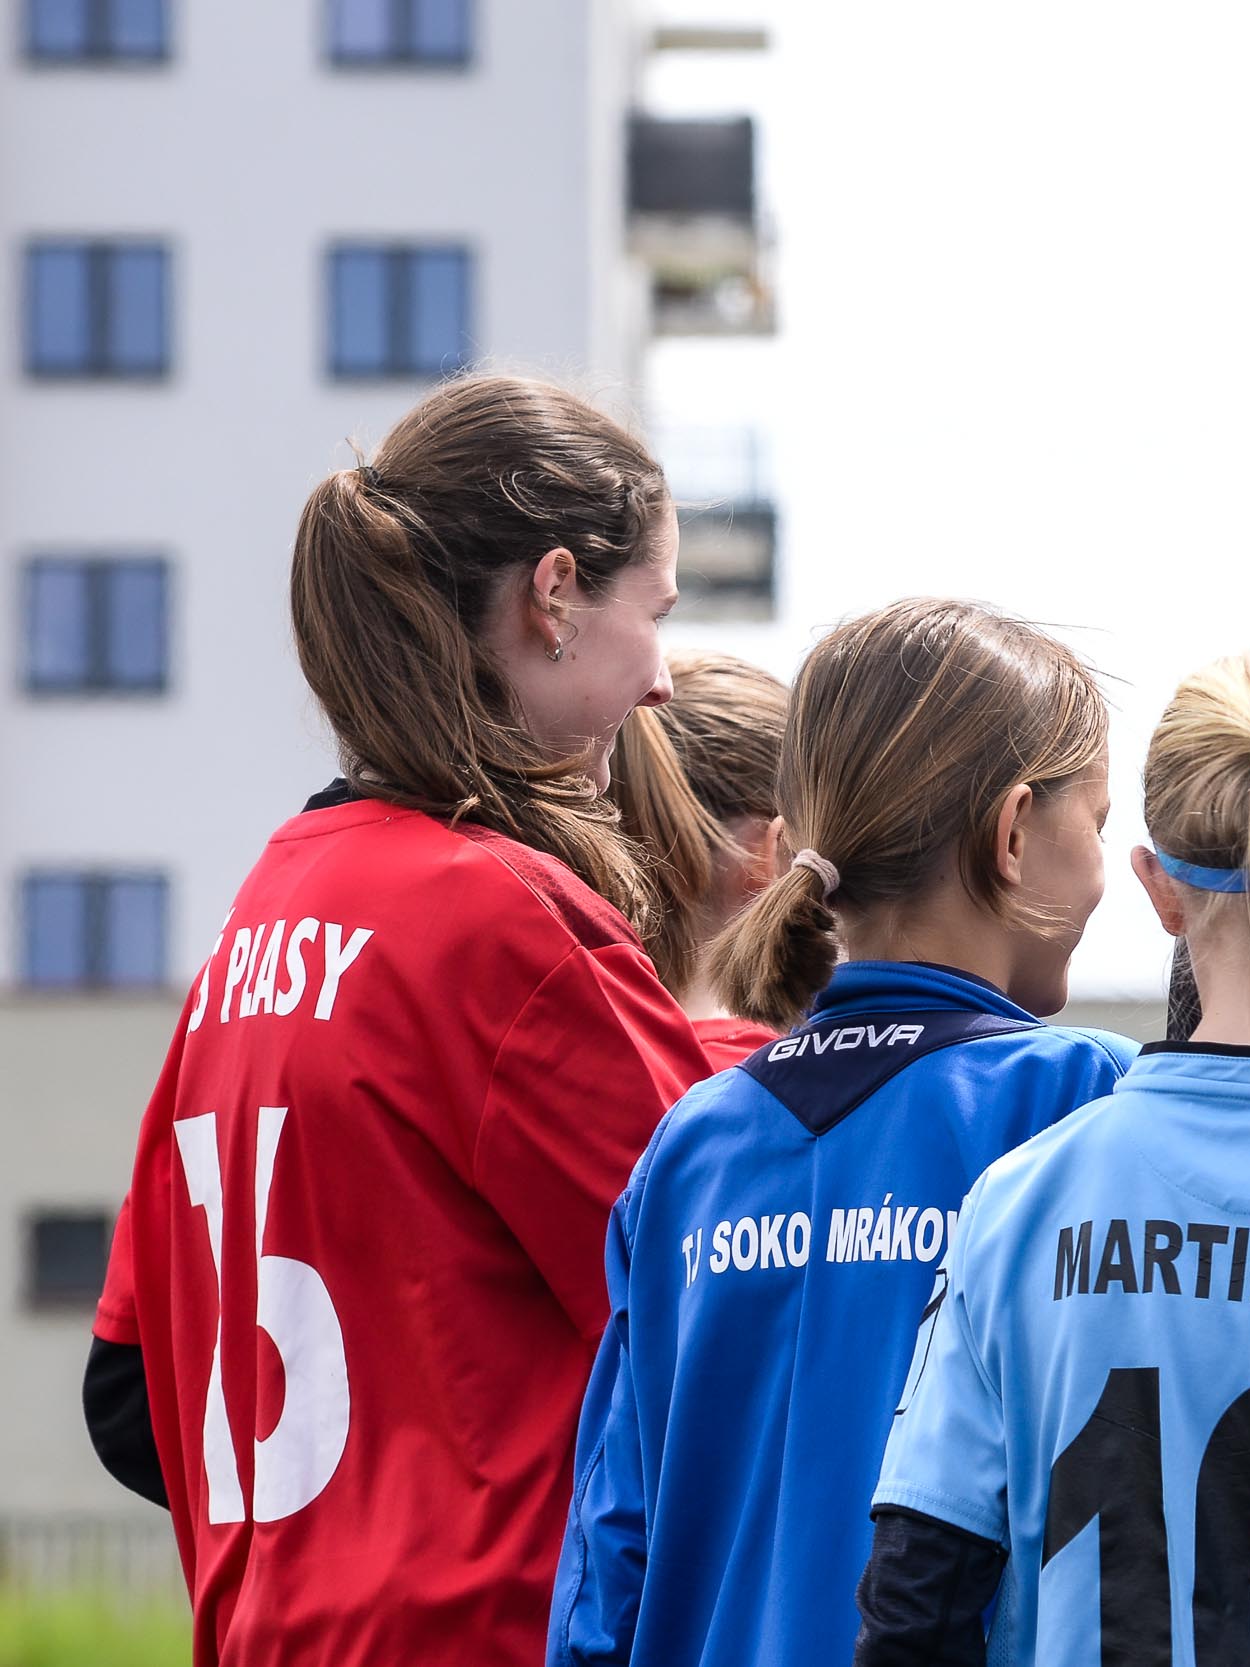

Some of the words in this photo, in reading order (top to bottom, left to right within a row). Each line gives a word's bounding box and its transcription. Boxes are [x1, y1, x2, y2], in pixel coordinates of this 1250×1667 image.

[219, 917, 375, 1024] PLASY
[768, 1024, 924, 1062] GIVOVA
[682, 1227, 703, 1289] TJ
[709, 1211, 812, 1273] SOKO
[173, 1106, 350, 1525] 16
